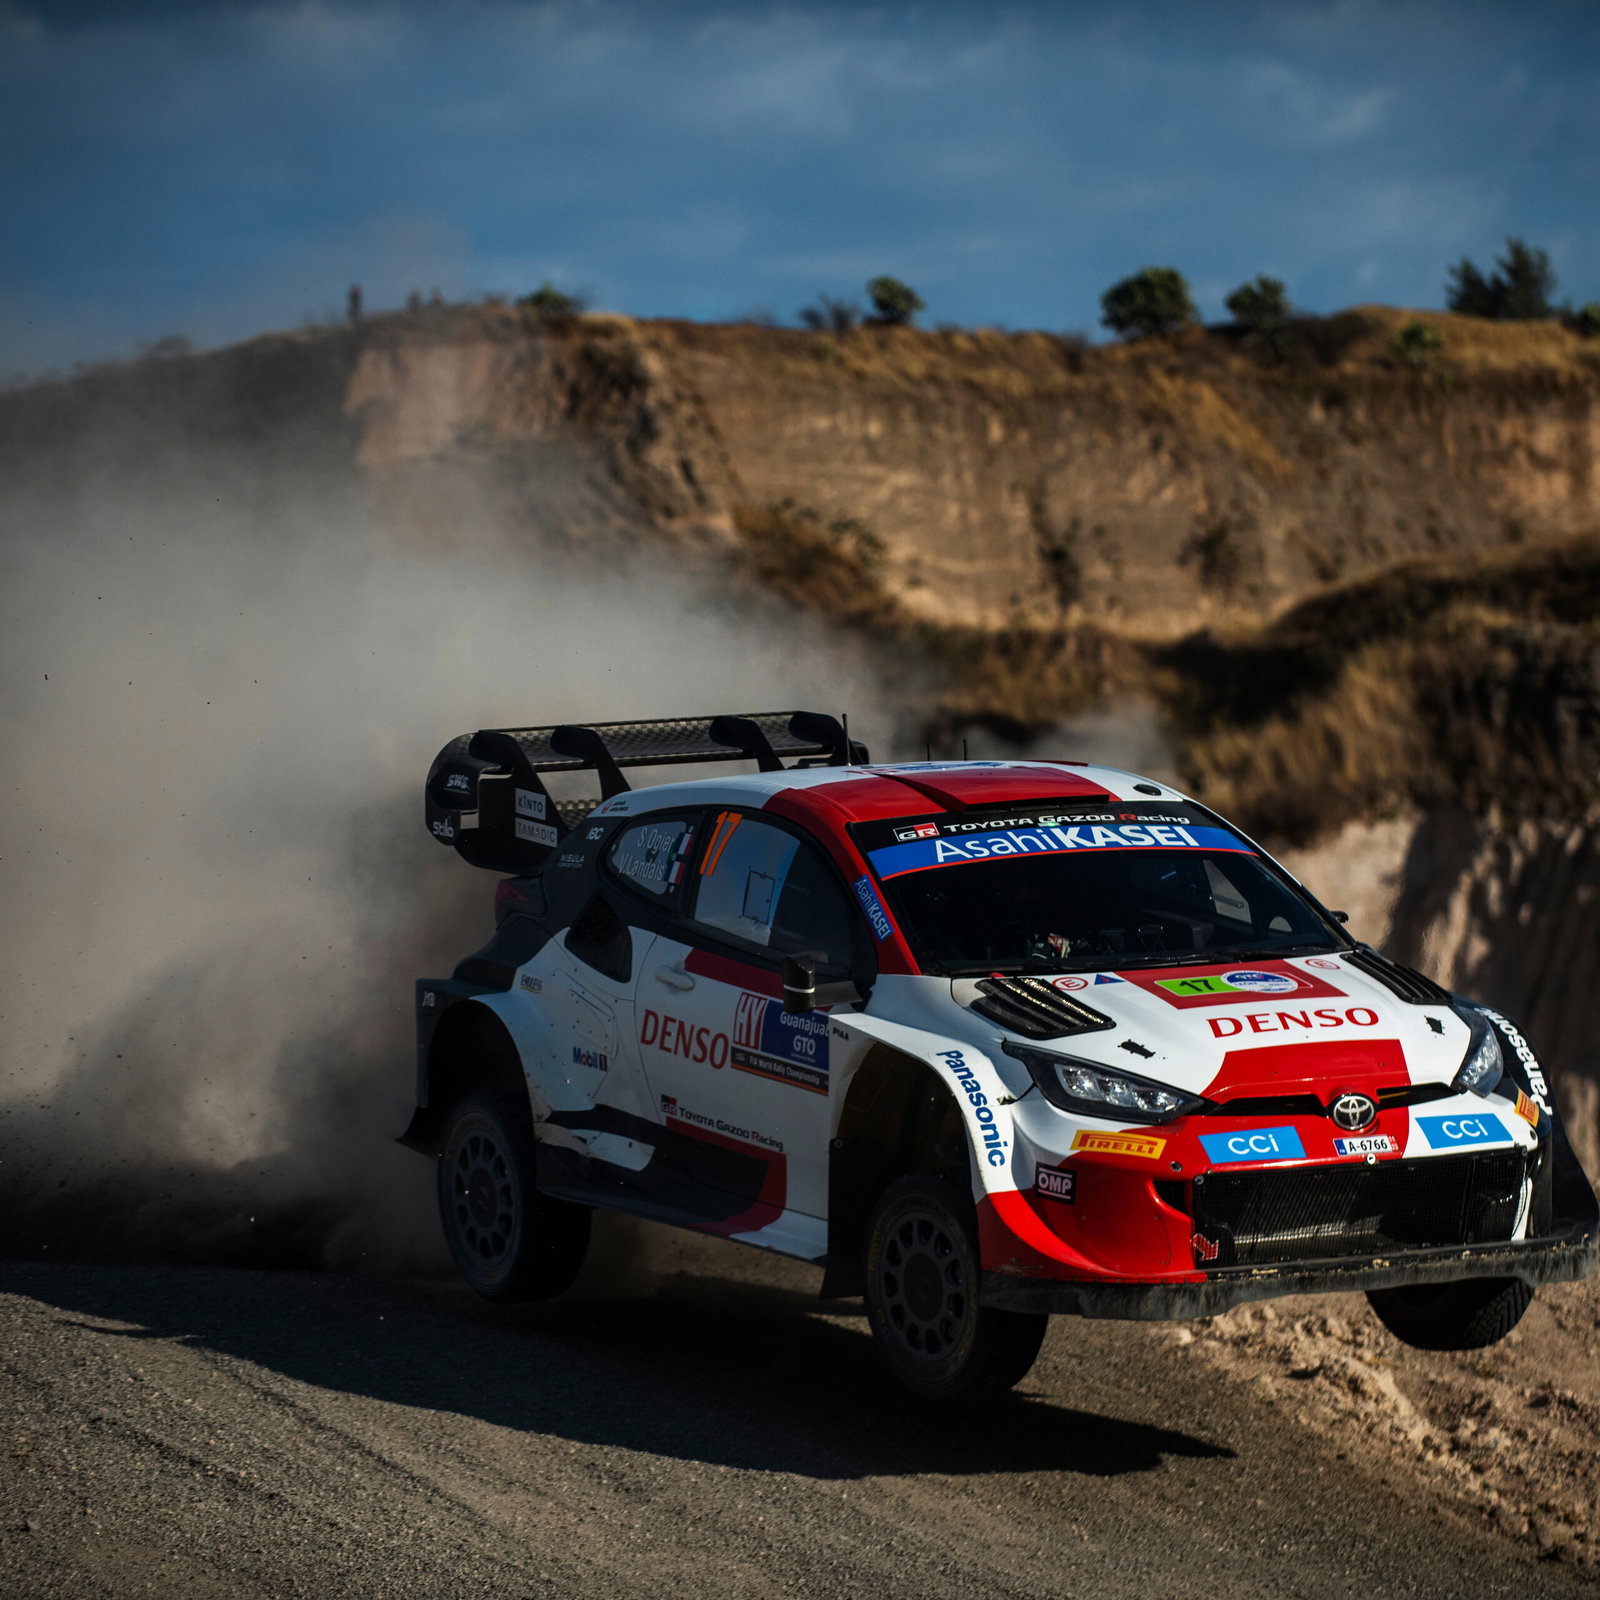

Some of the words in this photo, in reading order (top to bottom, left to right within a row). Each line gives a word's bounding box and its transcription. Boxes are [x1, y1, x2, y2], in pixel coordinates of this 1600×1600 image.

[518, 795, 543, 814] KINTO
[517, 822, 556, 843] TAMADIC
[898, 826, 939, 840] GR
[943, 817, 1034, 833] TOYOTA
[1037, 814, 1115, 825] GAZOO
[1118, 813, 1190, 825] Racing
[698, 810, 744, 877] 17
[934, 825, 1200, 862] AsahiKASEI
[855, 878, 891, 940] AsahiKASEI
[1179, 979, 1216, 992] 17
[832, 1027, 849, 1041] PIAA
[1206, 1007, 1380, 1039] DENSO
[640, 1009, 729, 1069] DENSO
[793, 1035, 816, 1056] GTO
[573, 1046, 599, 1069] Mobil
[937, 1050, 1008, 1167] Panasonic
[679, 1107, 714, 1128] TOYOTA
[716, 1120, 750, 1139] GAZOO
[751, 1130, 784, 1152] Racing
[1077, 1133, 1158, 1155] PIRELLI
[1348, 1139, 1388, 1152] A-6766
[1037, 1172, 1073, 1195] OMP
